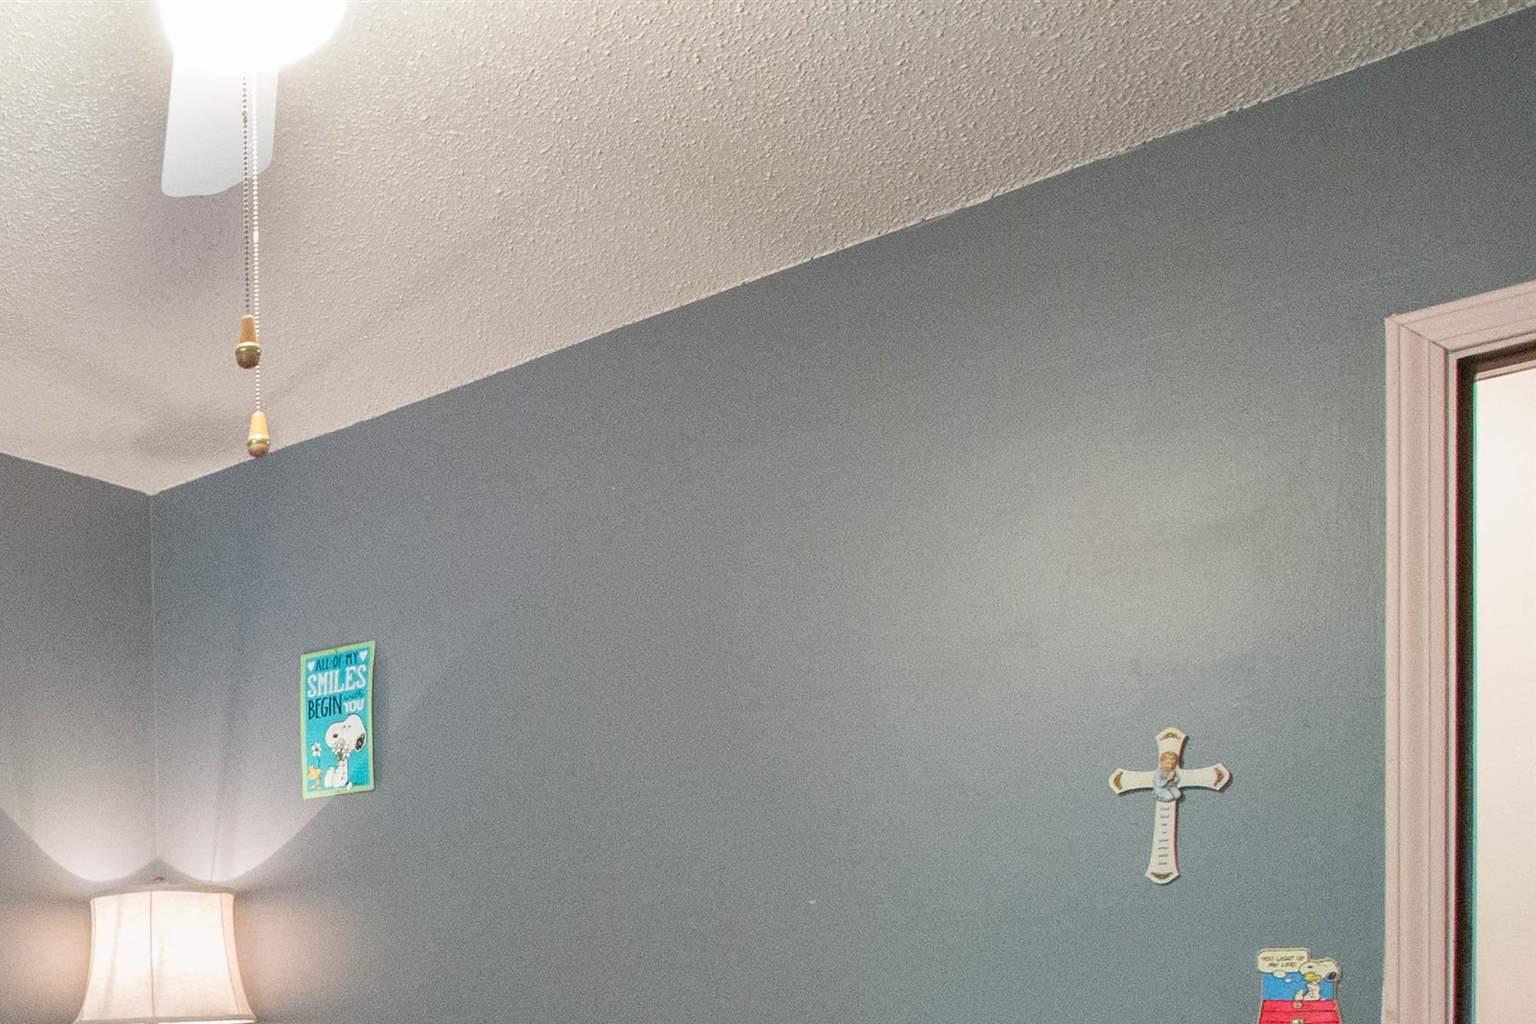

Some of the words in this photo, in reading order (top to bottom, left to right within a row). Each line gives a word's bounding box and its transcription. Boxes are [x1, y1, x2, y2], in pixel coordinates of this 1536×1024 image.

[316, 658, 329, 672] ALL
[346, 651, 359, 665] MY
[307, 664, 367, 698] SMILES
[308, 694, 343, 720] BEGIN
[344, 698, 364, 713] YOU
